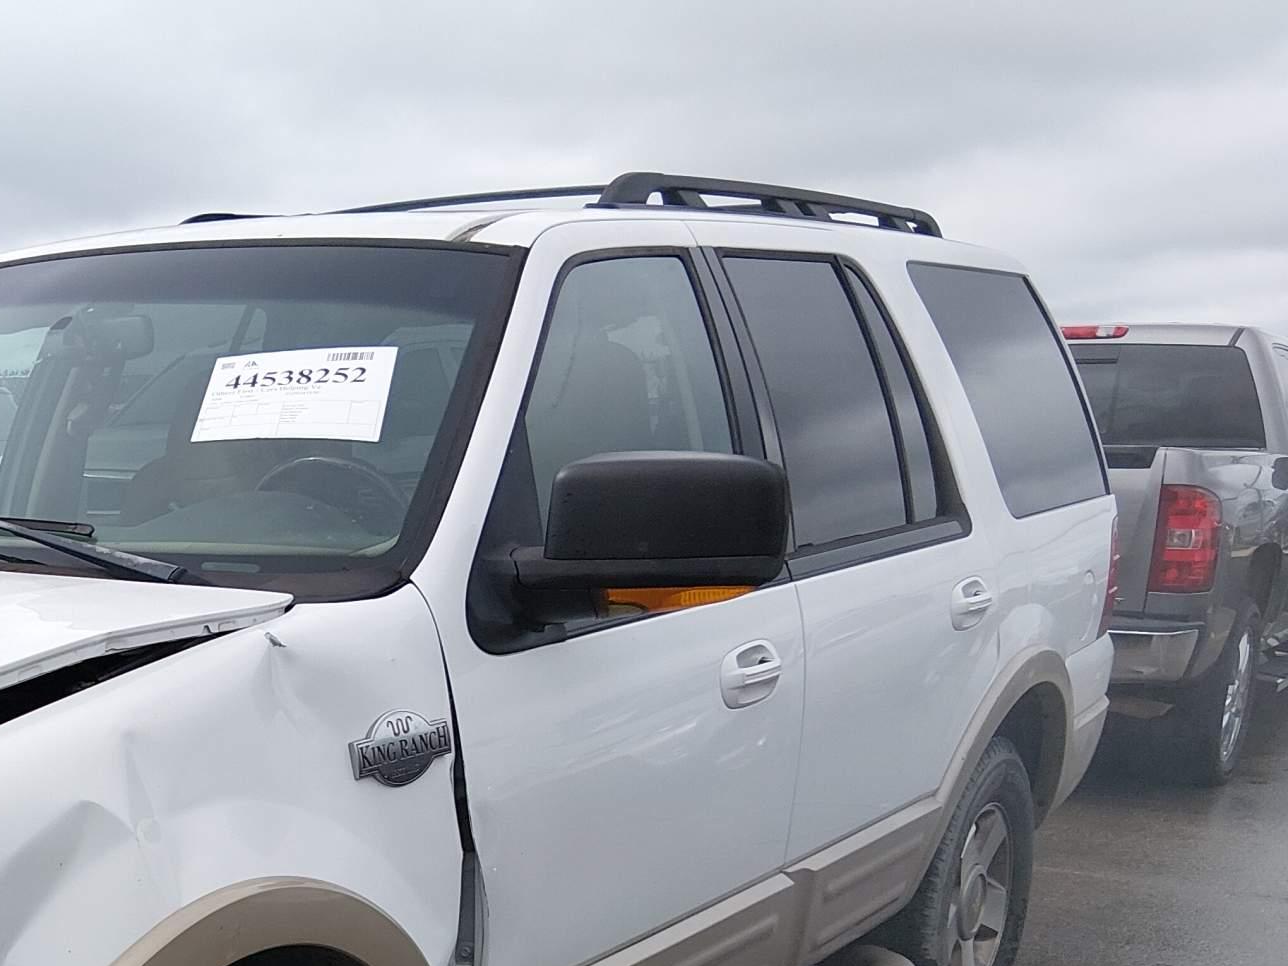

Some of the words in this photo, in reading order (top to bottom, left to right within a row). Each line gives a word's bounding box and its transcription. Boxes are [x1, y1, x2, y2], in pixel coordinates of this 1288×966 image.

[225, 366, 368, 390] 44538252
[359, 742, 397, 769] KING
[398, 725, 448, 758] RANCH
